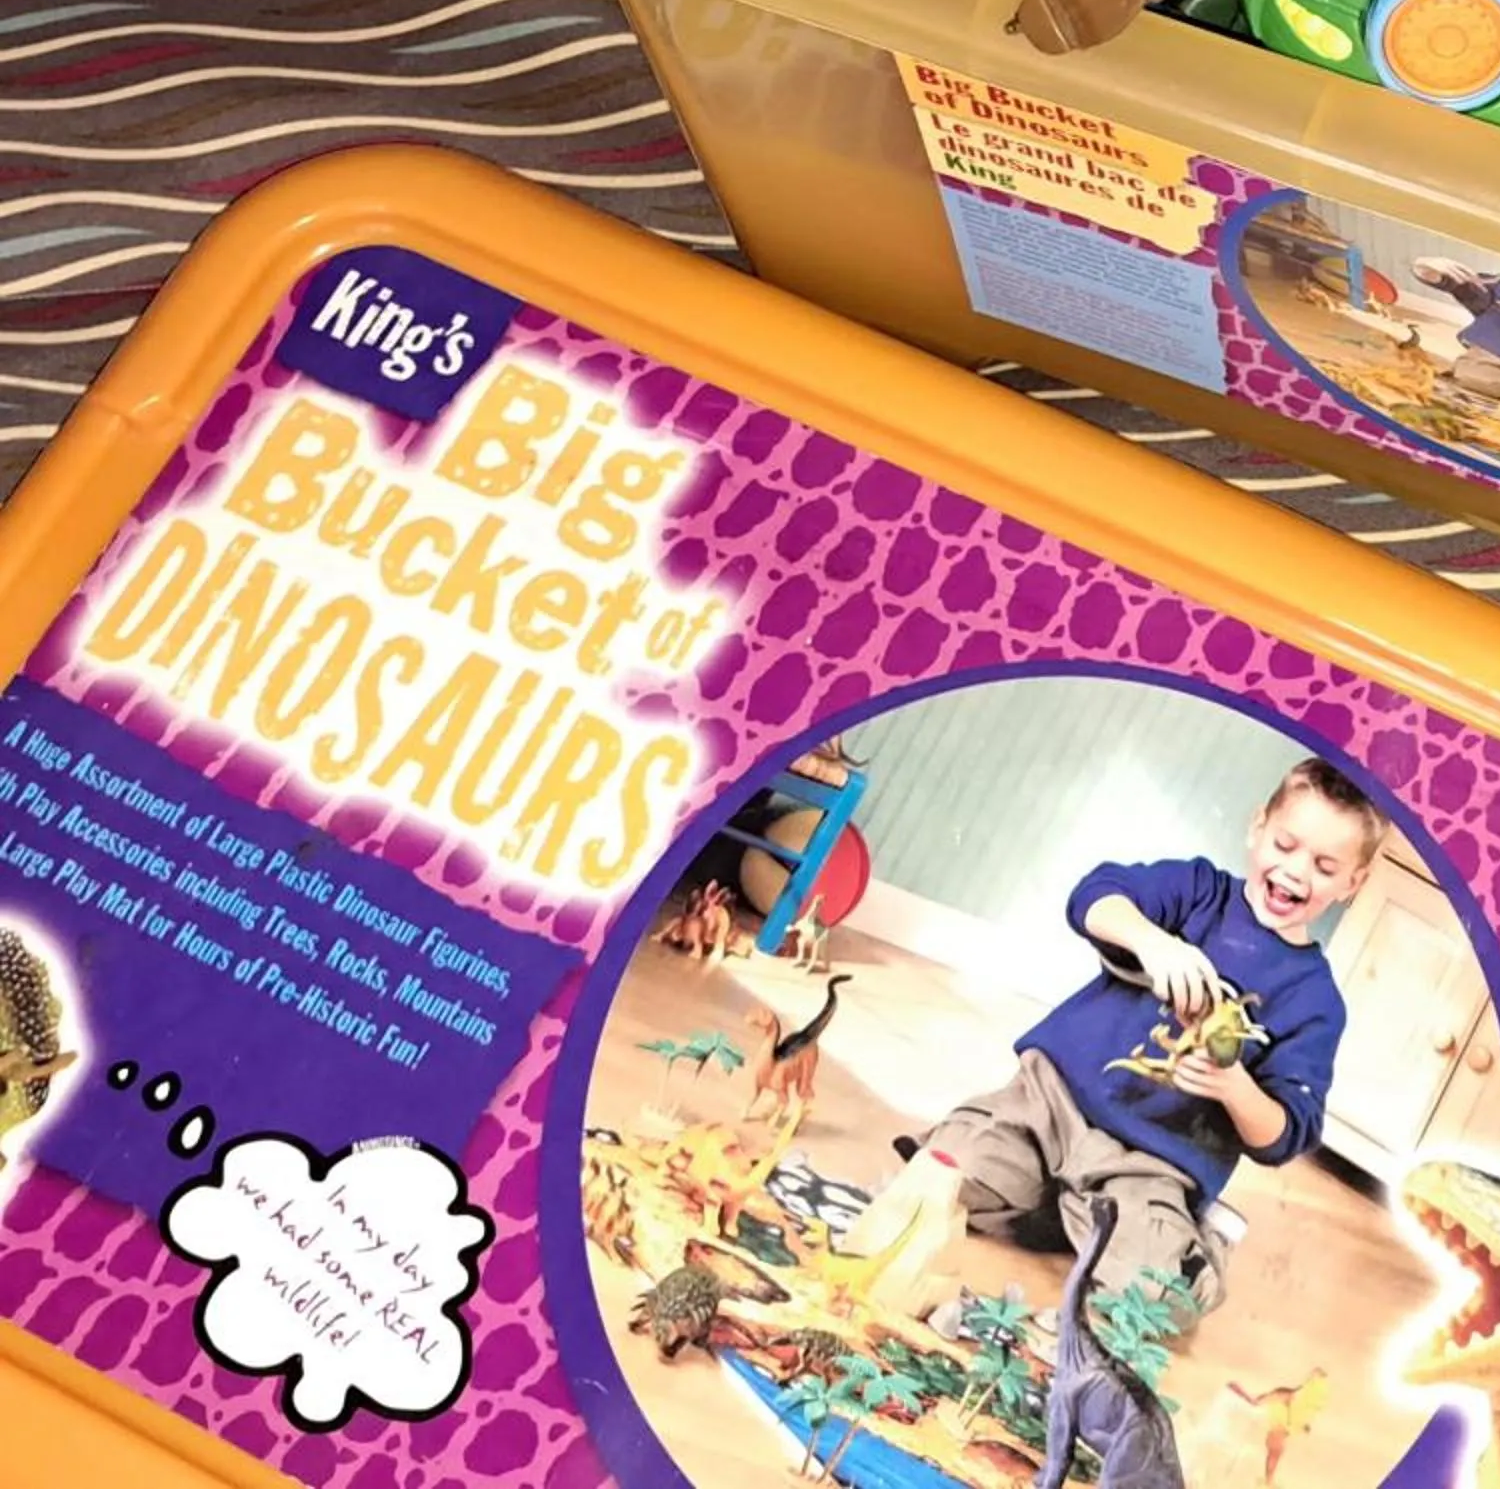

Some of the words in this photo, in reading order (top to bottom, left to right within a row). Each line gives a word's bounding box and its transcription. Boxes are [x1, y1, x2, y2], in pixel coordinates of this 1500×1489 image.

[915, 64, 973, 98] Big
[986, 84, 1116, 140] Bucket
[924, 90, 957, 110] of
[970, 94, 1149, 168] Dinosaurs
[931, 112, 971, 138] Le
[983, 132, 1074, 170] grand
[1087, 159, 1145, 192] bac
[1157, 185, 1197, 208] de
[939, 135, 1115, 200] dinosaures
[1126, 194, 1165, 218] de
[944, 152, 1017, 191] King
[311, 269, 475, 382] King's
[433, 363, 688, 562] Big
[223, 397, 647, 679] Bucket
[646, 603, 717, 671] of
[83, 517, 692, 890] DINOSAURS
[4, 719, 28, 748] A
[22, 727, 72, 771] Huge
[70, 752, 189, 829] Assortment
[184, 813, 216, 841] of
[206, 820, 265, 869] Large
[264, 849, 335, 905] Plastic
[333, 884, 422, 947] Dinosaur
[419, 926, 511, 1001] Figurines,
[16, 782, 62, 826] Play
[58, 805, 177, 882] Accessories
[174, 861, 267, 931] including
[263, 905, 320, 962] Trees,
[324, 937, 389, 998] Rocks,
[393, 974, 497, 1046] Mountains
[0, 831, 54, 878] Large
[52, 858, 102, 905] Play
[96, 882, 146, 925] Mat
[139, 903, 176, 940] for
[173, 920, 235, 971] Hours
[234, 956, 266, 984] of
[257, 963, 378, 1046] Pre-Historic
[376, 1023, 431, 1070] Fun!
[237, 1177, 267, 1209] we
[269, 1199, 324, 1249] had
[315, 1251, 373, 1305] some
[375, 1297, 439, 1364] REAL
[327, 1185, 347, 1215] In
[352, 1216, 389, 1253] my
[393, 1244, 435, 1294] day
